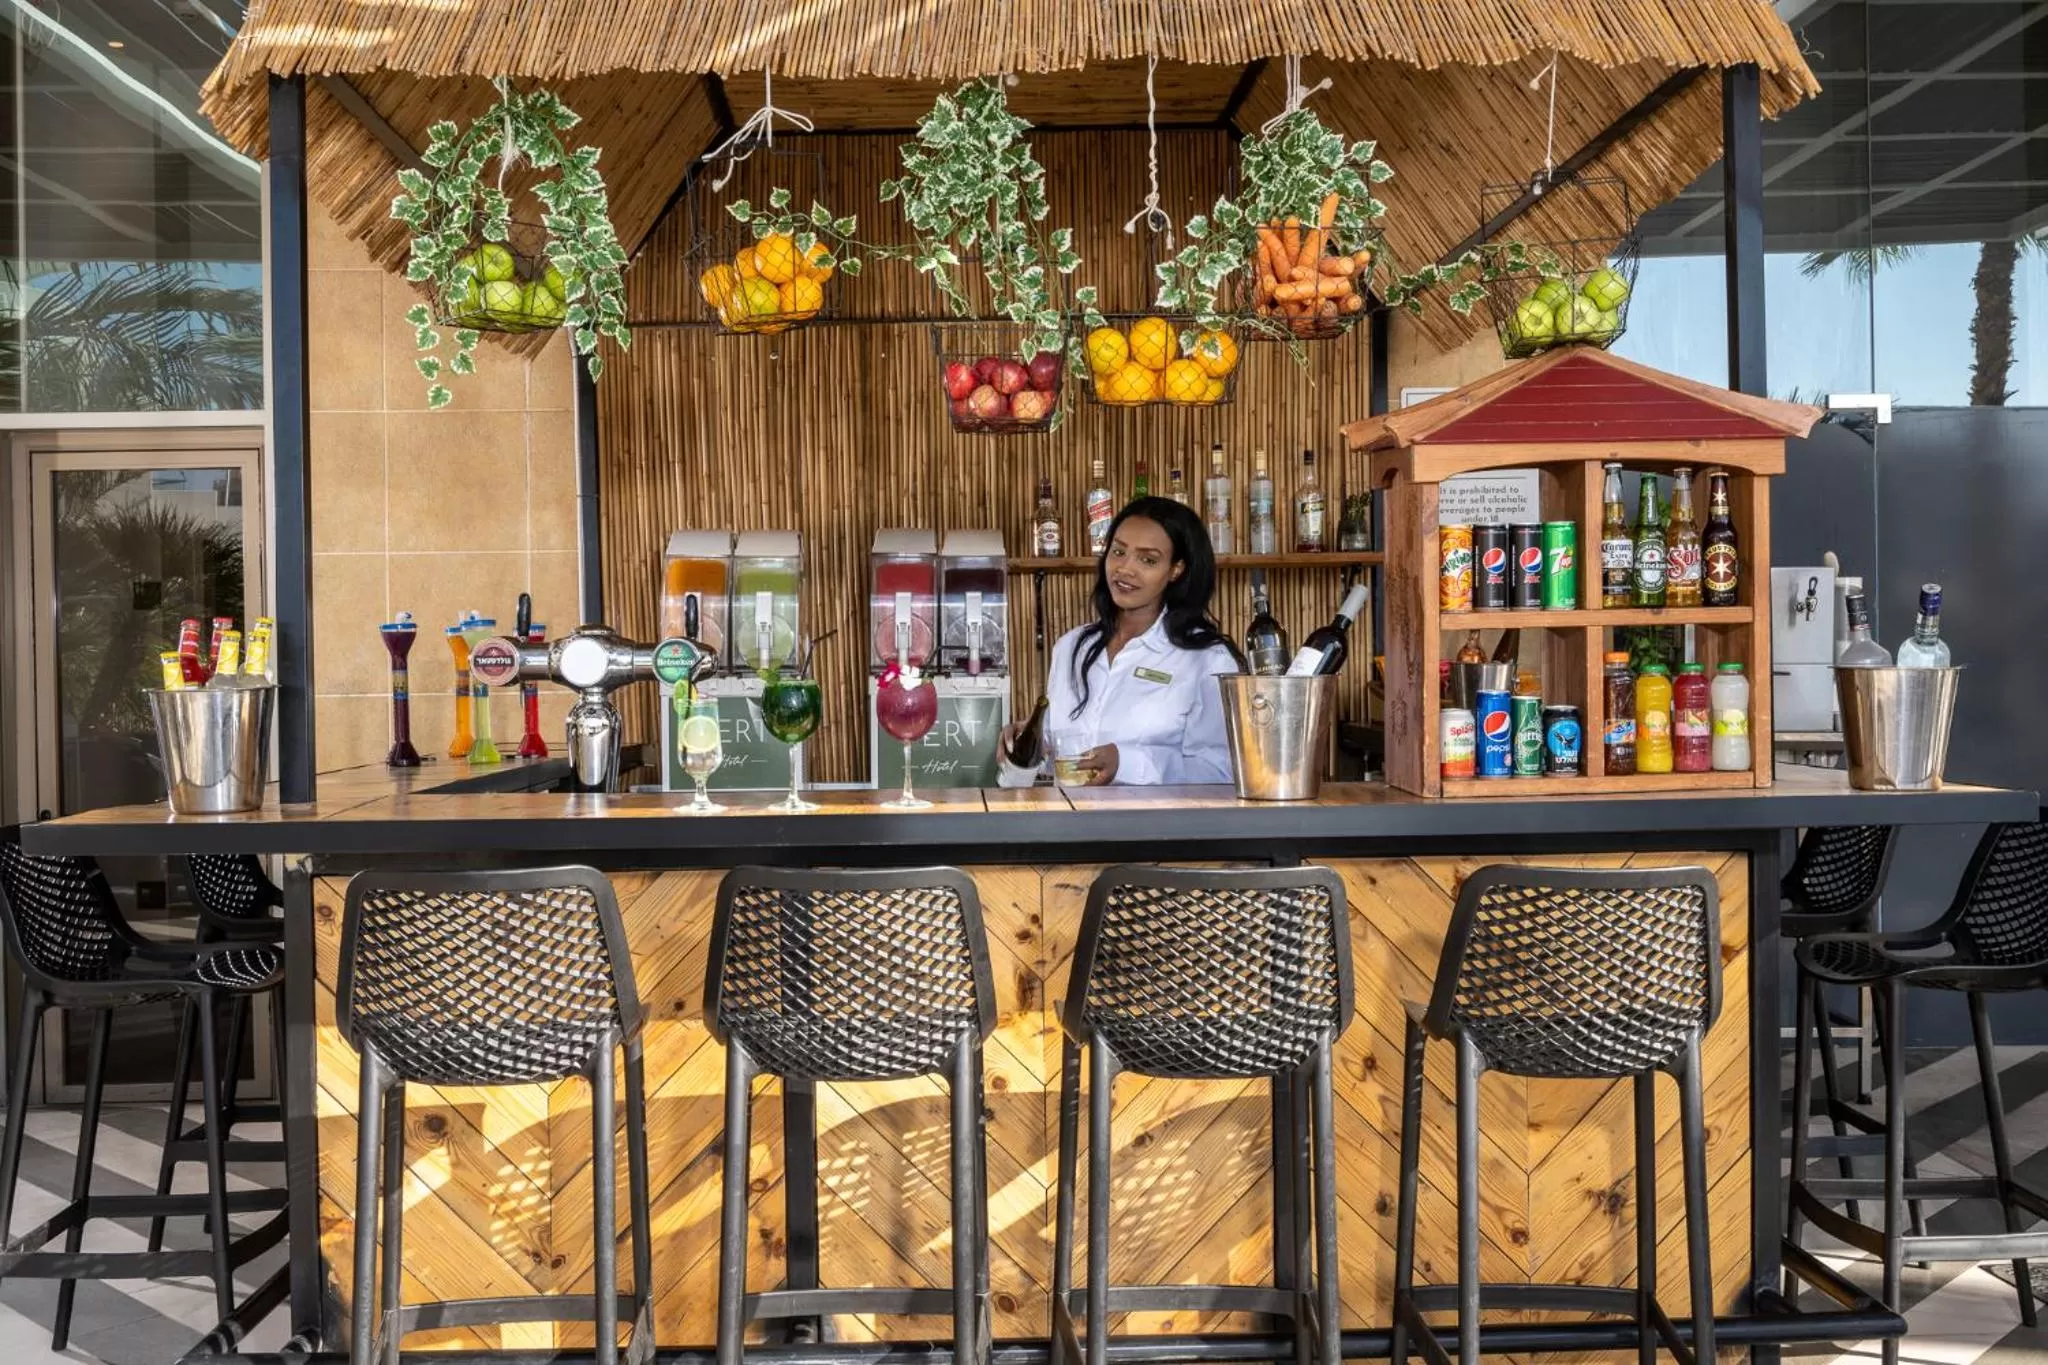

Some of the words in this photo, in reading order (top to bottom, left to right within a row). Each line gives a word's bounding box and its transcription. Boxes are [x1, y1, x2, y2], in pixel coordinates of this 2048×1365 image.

[1449, 486, 1457, 494] is
[1459, 484, 1507, 497] prohibited
[1509, 485, 1519, 494] to
[1457, 497, 1467, 505] or
[1470, 493, 1485, 503] sell
[1487, 494, 1528, 504] alcoholic
[1439, 506, 1480, 516] everages
[1483, 505, 1493, 514] to
[1495, 503, 1526, 515] people
[1461, 514, 1487, 523] under
[1490, 514, 1499, 522] 18
[719, 718, 764, 743] ERT
[923, 719, 983, 747] ERT
[921, 759, 959, 775] Hotel
